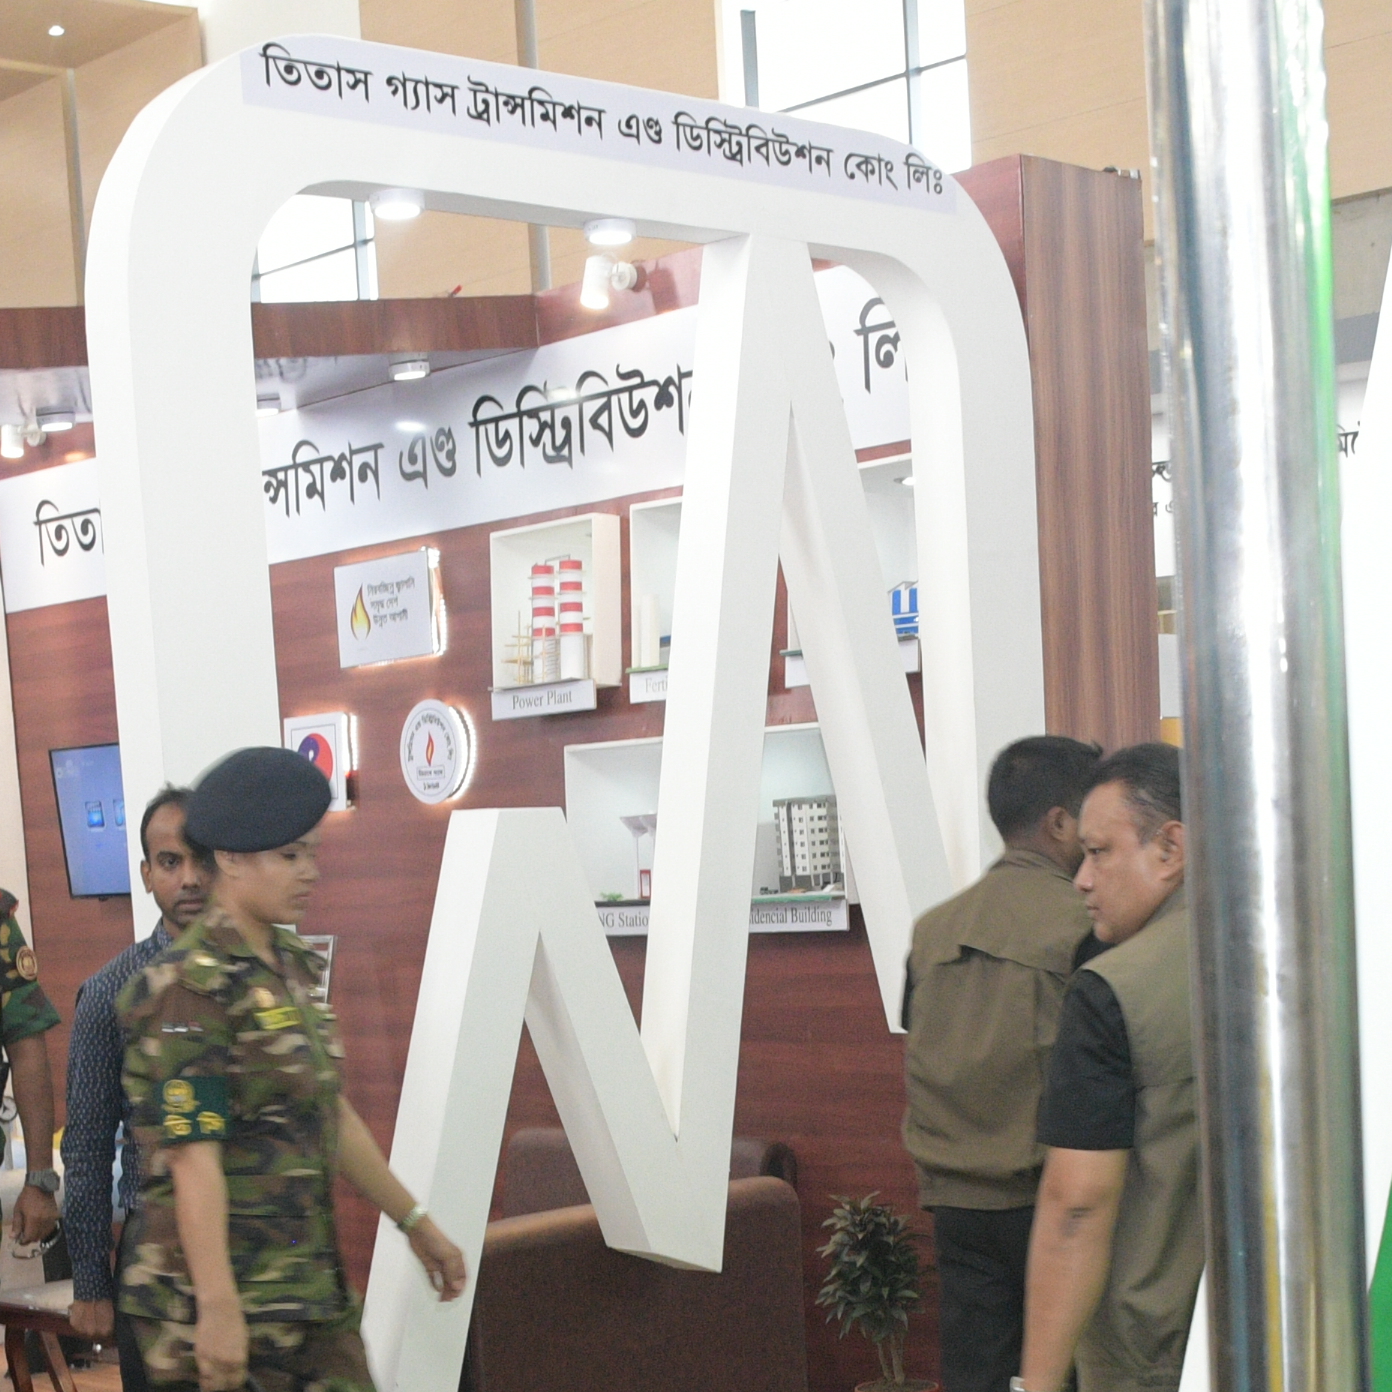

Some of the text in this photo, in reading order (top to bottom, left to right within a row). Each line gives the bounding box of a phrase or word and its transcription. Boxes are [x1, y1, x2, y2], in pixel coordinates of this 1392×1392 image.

[259, 42, 373, 102] তিতাস
[386, 71, 460, 117] গ্যাস
[466, 74, 606, 140] ট্রান্সমিশন
[671, 110, 834, 178] ডিস্ট্রিবিউশন
[843, 150, 898, 191] কোং
[905, 152, 944, 195] লিঃ
[468, 363, 694, 478] ডিস্ট্রিবিউশ
[511, 689, 572, 710] Power Plant
[791, 907, 833, 926] Building
